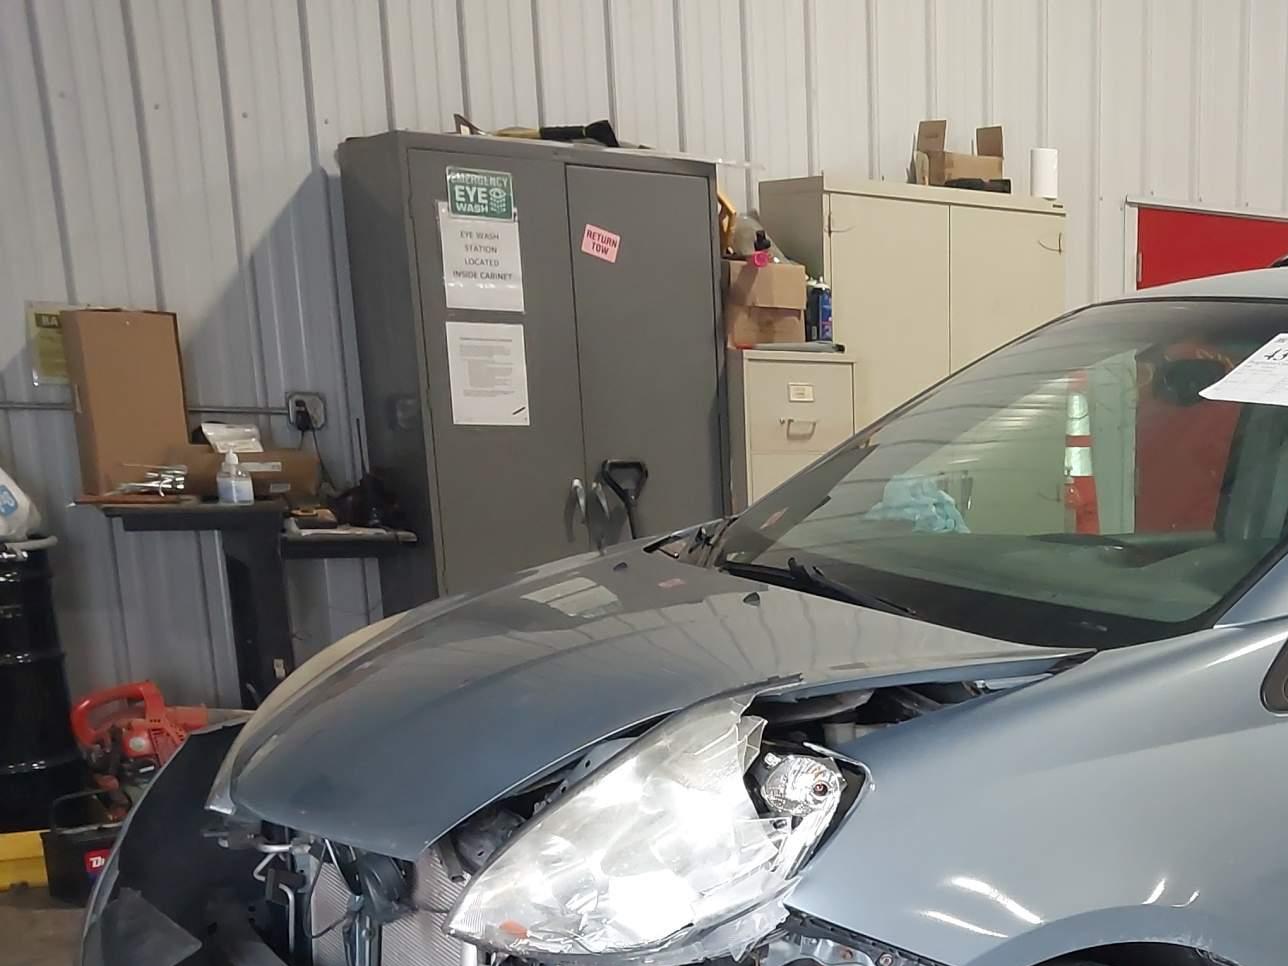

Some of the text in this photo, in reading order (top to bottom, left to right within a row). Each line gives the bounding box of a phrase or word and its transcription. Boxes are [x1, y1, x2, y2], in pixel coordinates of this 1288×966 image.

[455, 185, 488, 204] EYE
[456, 202, 488, 213] WASH
[460, 231, 500, 241] EYE WASH
[586, 229, 618, 249] RETURN
[464, 244, 498, 254] STATION
[591, 241, 610, 255] TOW
[464, 257, 500, 268] LOCATED
[452, 270, 513, 282] INSIDE CABINET
